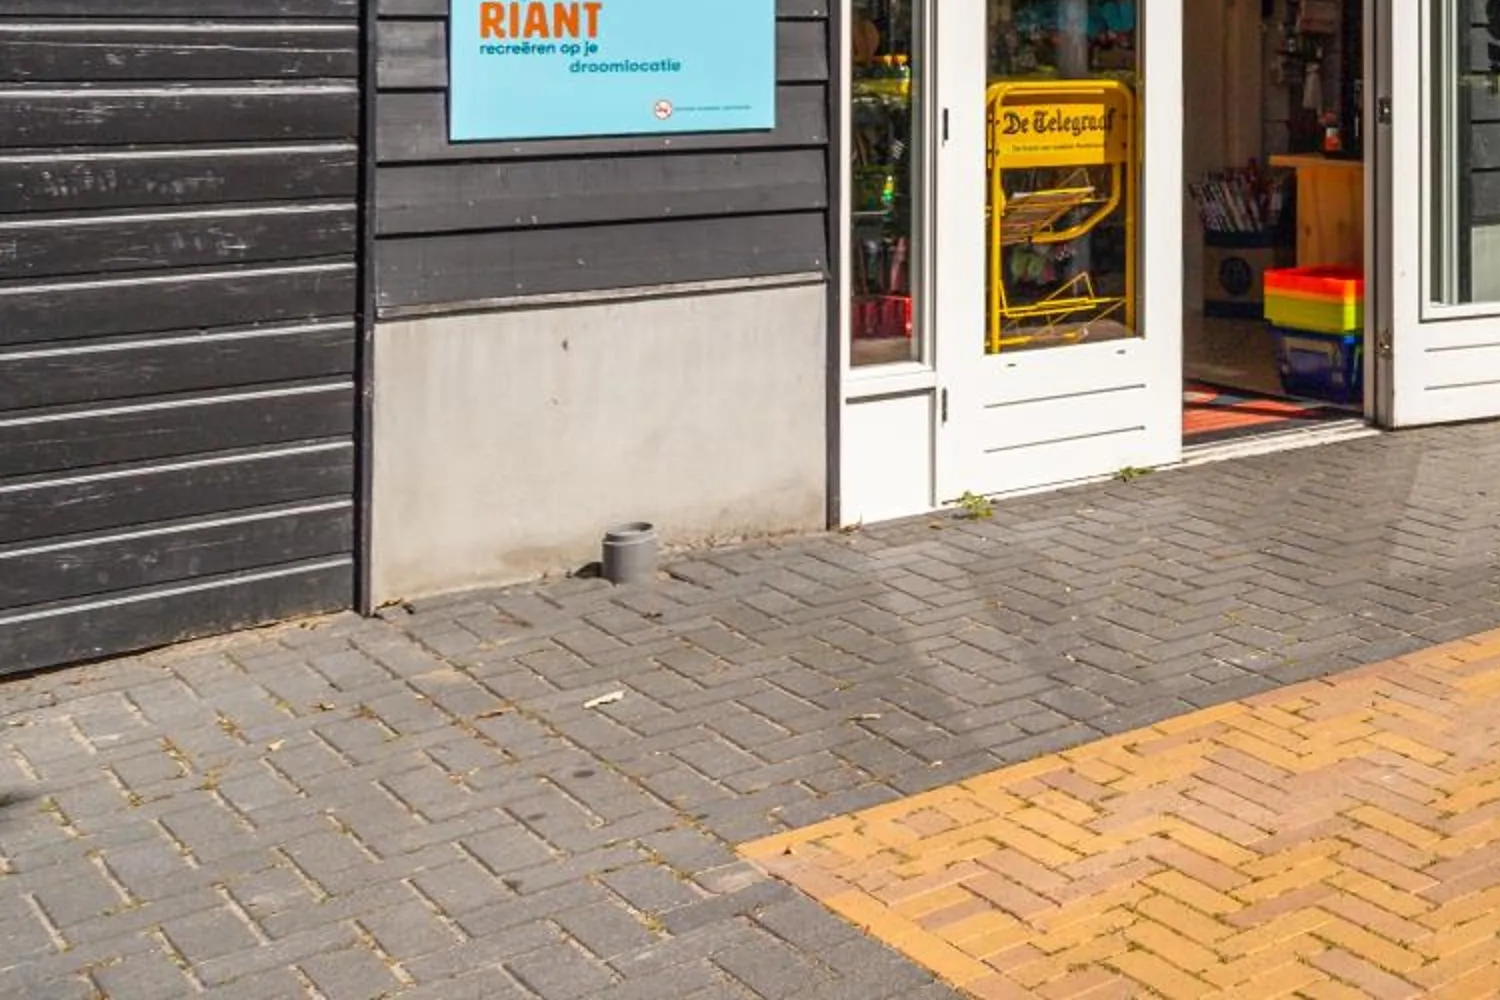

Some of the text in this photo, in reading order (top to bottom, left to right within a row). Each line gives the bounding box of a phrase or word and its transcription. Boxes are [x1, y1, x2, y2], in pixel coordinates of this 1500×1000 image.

[479, 1, 603, 39] RIANT
[560, 43, 581, 56] op
[583, 41, 599, 56] je
[569, 59, 681, 73] droomlocatie
[1002, 107, 1117, 136] De Telegraaf
